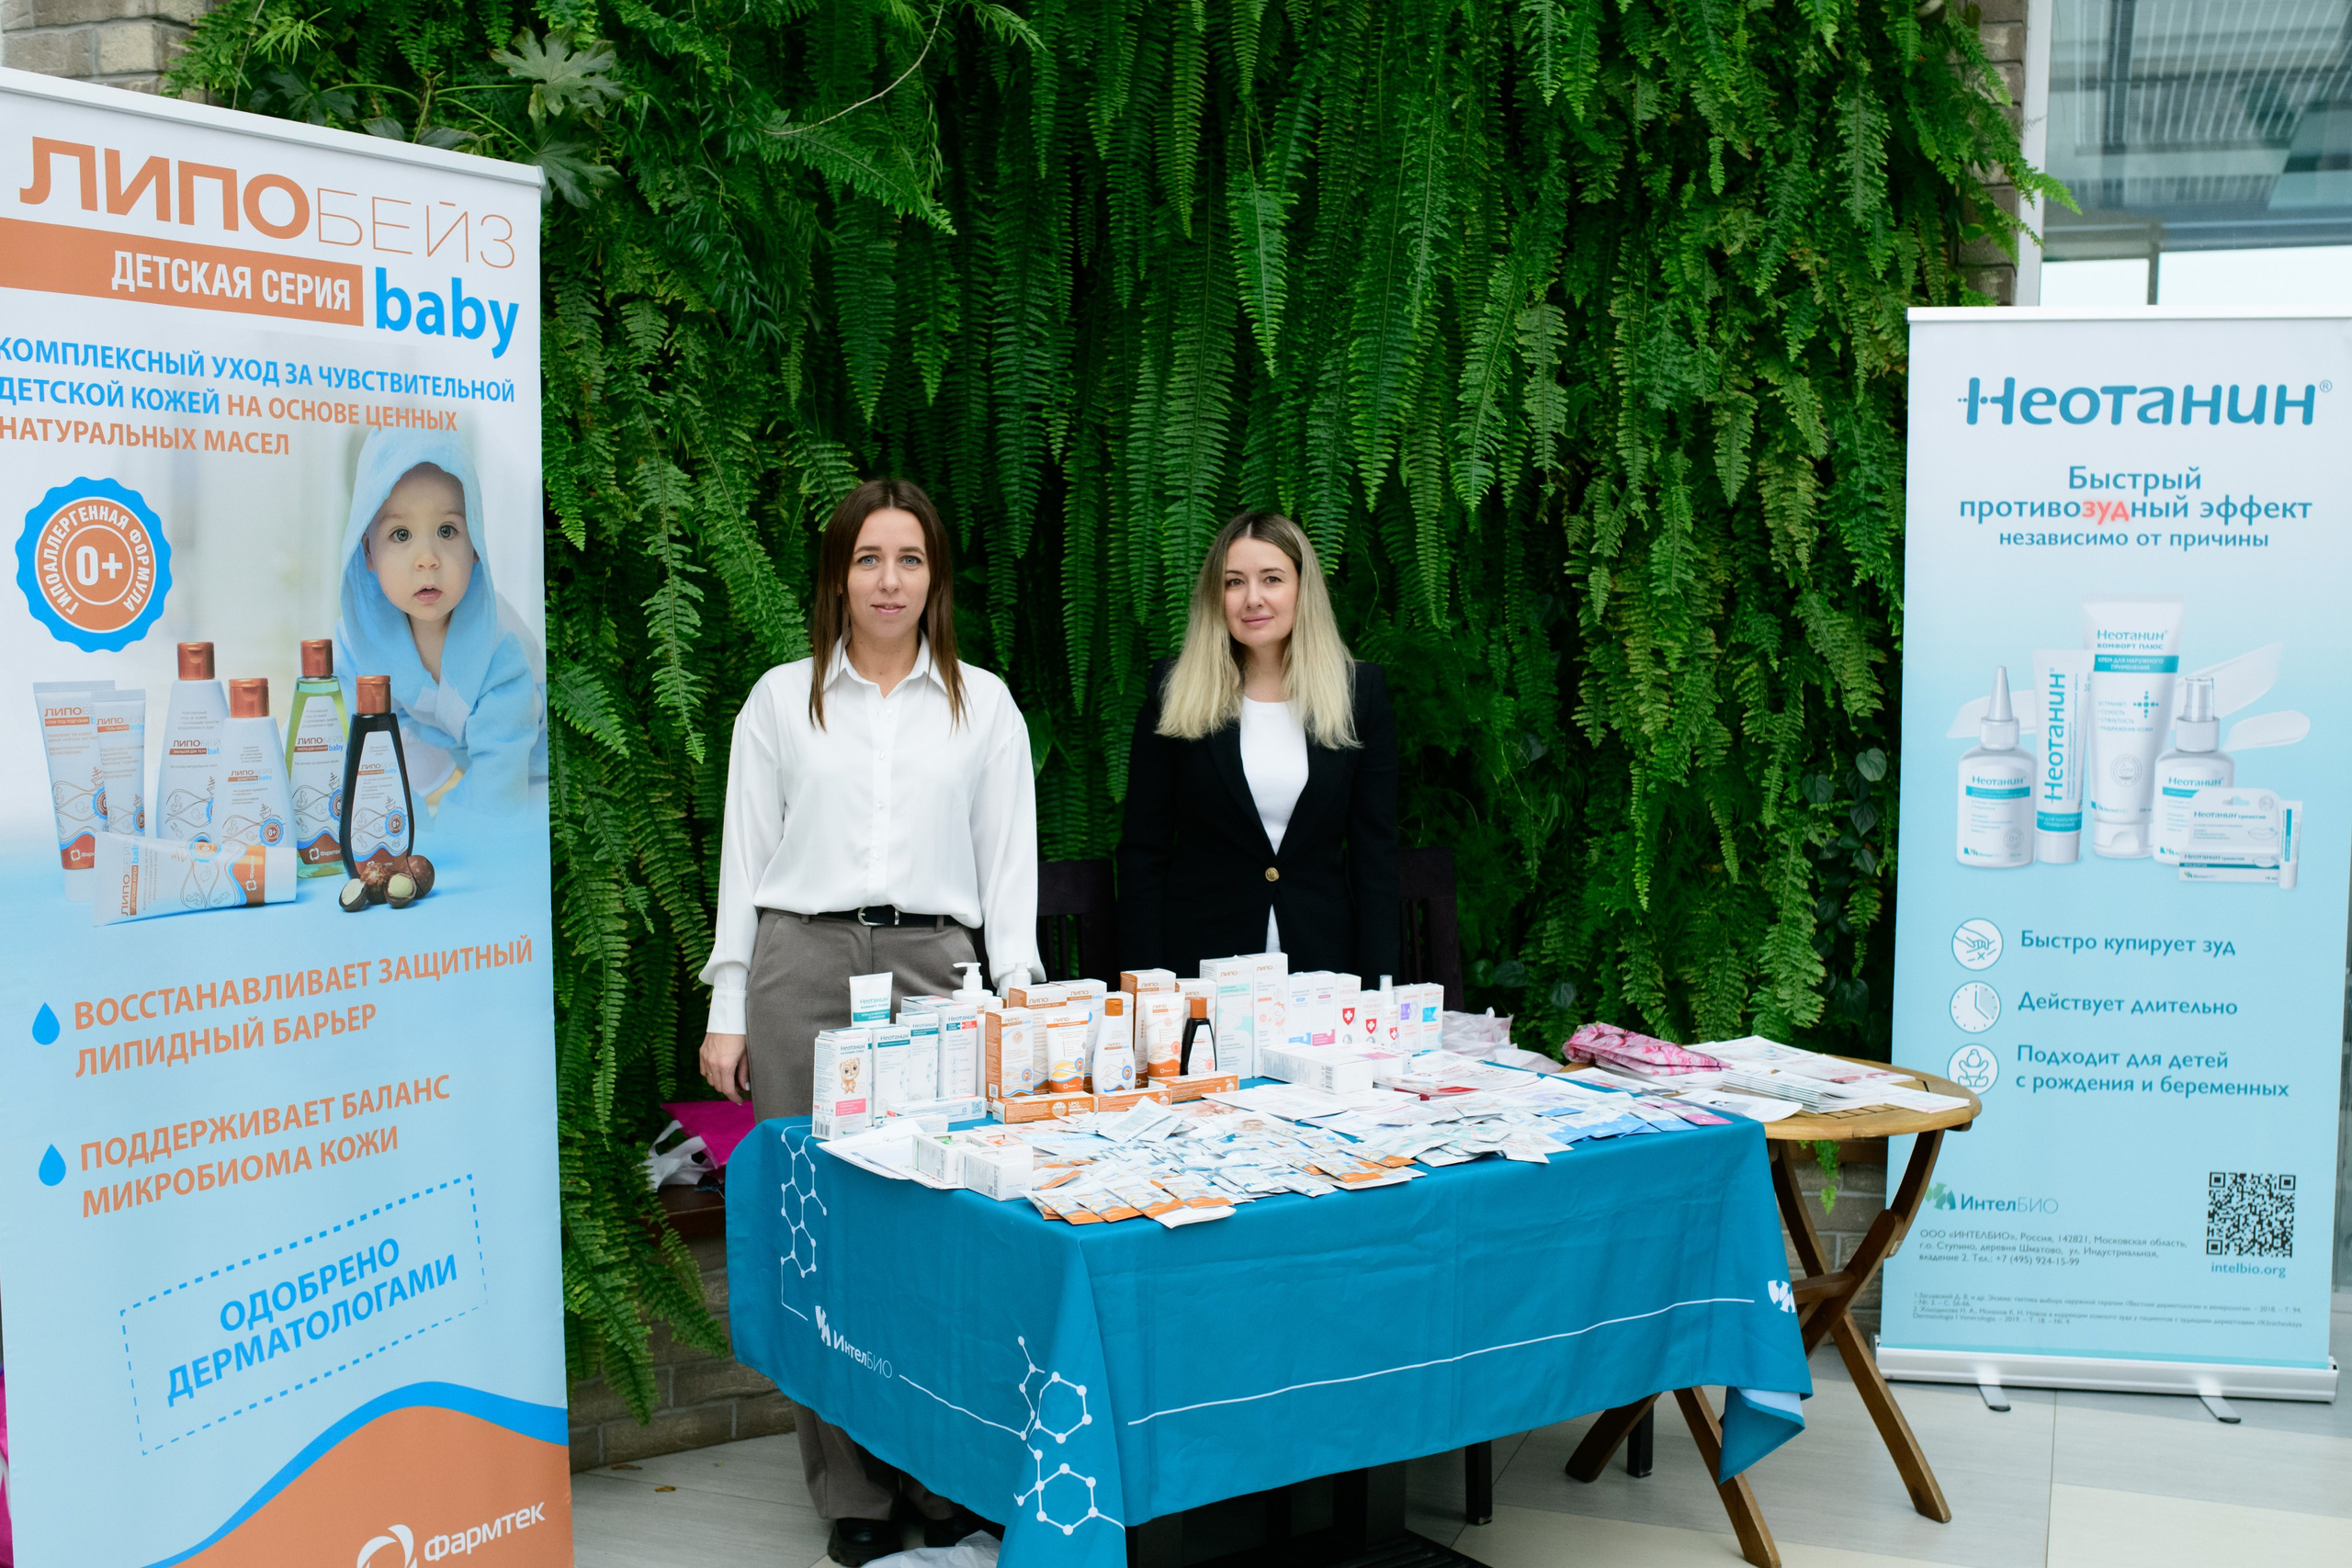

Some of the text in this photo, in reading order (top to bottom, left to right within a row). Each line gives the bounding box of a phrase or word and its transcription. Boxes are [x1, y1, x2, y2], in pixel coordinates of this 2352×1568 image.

[19, 136, 515, 269] ЛИПОБЕЙЗ
[111, 251, 351, 311] ДЕТСКАЯ СЕРИЯ
[375, 266, 519, 359] baby
[211, 355, 279, 388] УХОД
[286, 362, 313, 385] ЗА
[318, 365, 514, 403] ЧУВСТВИТЕЛЬНОЙ
[0, 377, 458, 432] ДЕТСКОЙ КОЖЕЙ НА ОСНОВЕ ЦЕННЫХ
[0, 417, 289, 456] НАТУРАЛЬНЫХ МАСЕЛ
[2068, 465, 2202, 498] Быстрый
[1959, 493, 2313, 527] противозудный эффект
[43, 505, 150, 615] ГИПОАЛЛЕРГЕННАЯ ФОРМУЛА
[76, 546, 122, 585] 0+
[1998, 531, 2269, 553] независимо от причины
[2021, 930, 2235, 958] Быстро купирует зуд
[74, 938, 533, 1031] ВОССТАНАВЛИВАЕТ ЗАЩИТНЫЙ
[2018, 991, 2238, 1016] Действует длительно
[75, 1003, 377, 1078] ЛИПИДНЫЙ БАРЬЕР
[2017, 1044, 2228, 1068] Подходит для детей
[2016, 1075, 2289, 1098] с рождения и беременных
[80, 1074, 450, 1171] ПОДДЕРЖИВАЕТ БАЛАНС
[83, 1125, 399, 1218] МИКРОБИОМА КОЖИ
[1961, 1193, 2059, 1214] ИнтелБИО
[1920, 1230, 1946, 1238] ООО
[2020, 1232, 2054, 1243] Россия,
[2094, 1235, 2147, 1245] Московская
[1996, 1255, 2007, 1263] +7
[2009, 1255, 2032, 1266] (495)
[2036, 1256, 2080, 1266] 924-15-99
[220, 1237, 400, 1331] ОДОБРЕНО
[2211, 1262, 2286, 1278] intelbio.org
[166, 1254, 458, 1407] ДЕРМАТОЛОГАМИ
[833, 1329, 893, 1379] ИнтелБИО
[424, 1501, 546, 1563] Фармтек
